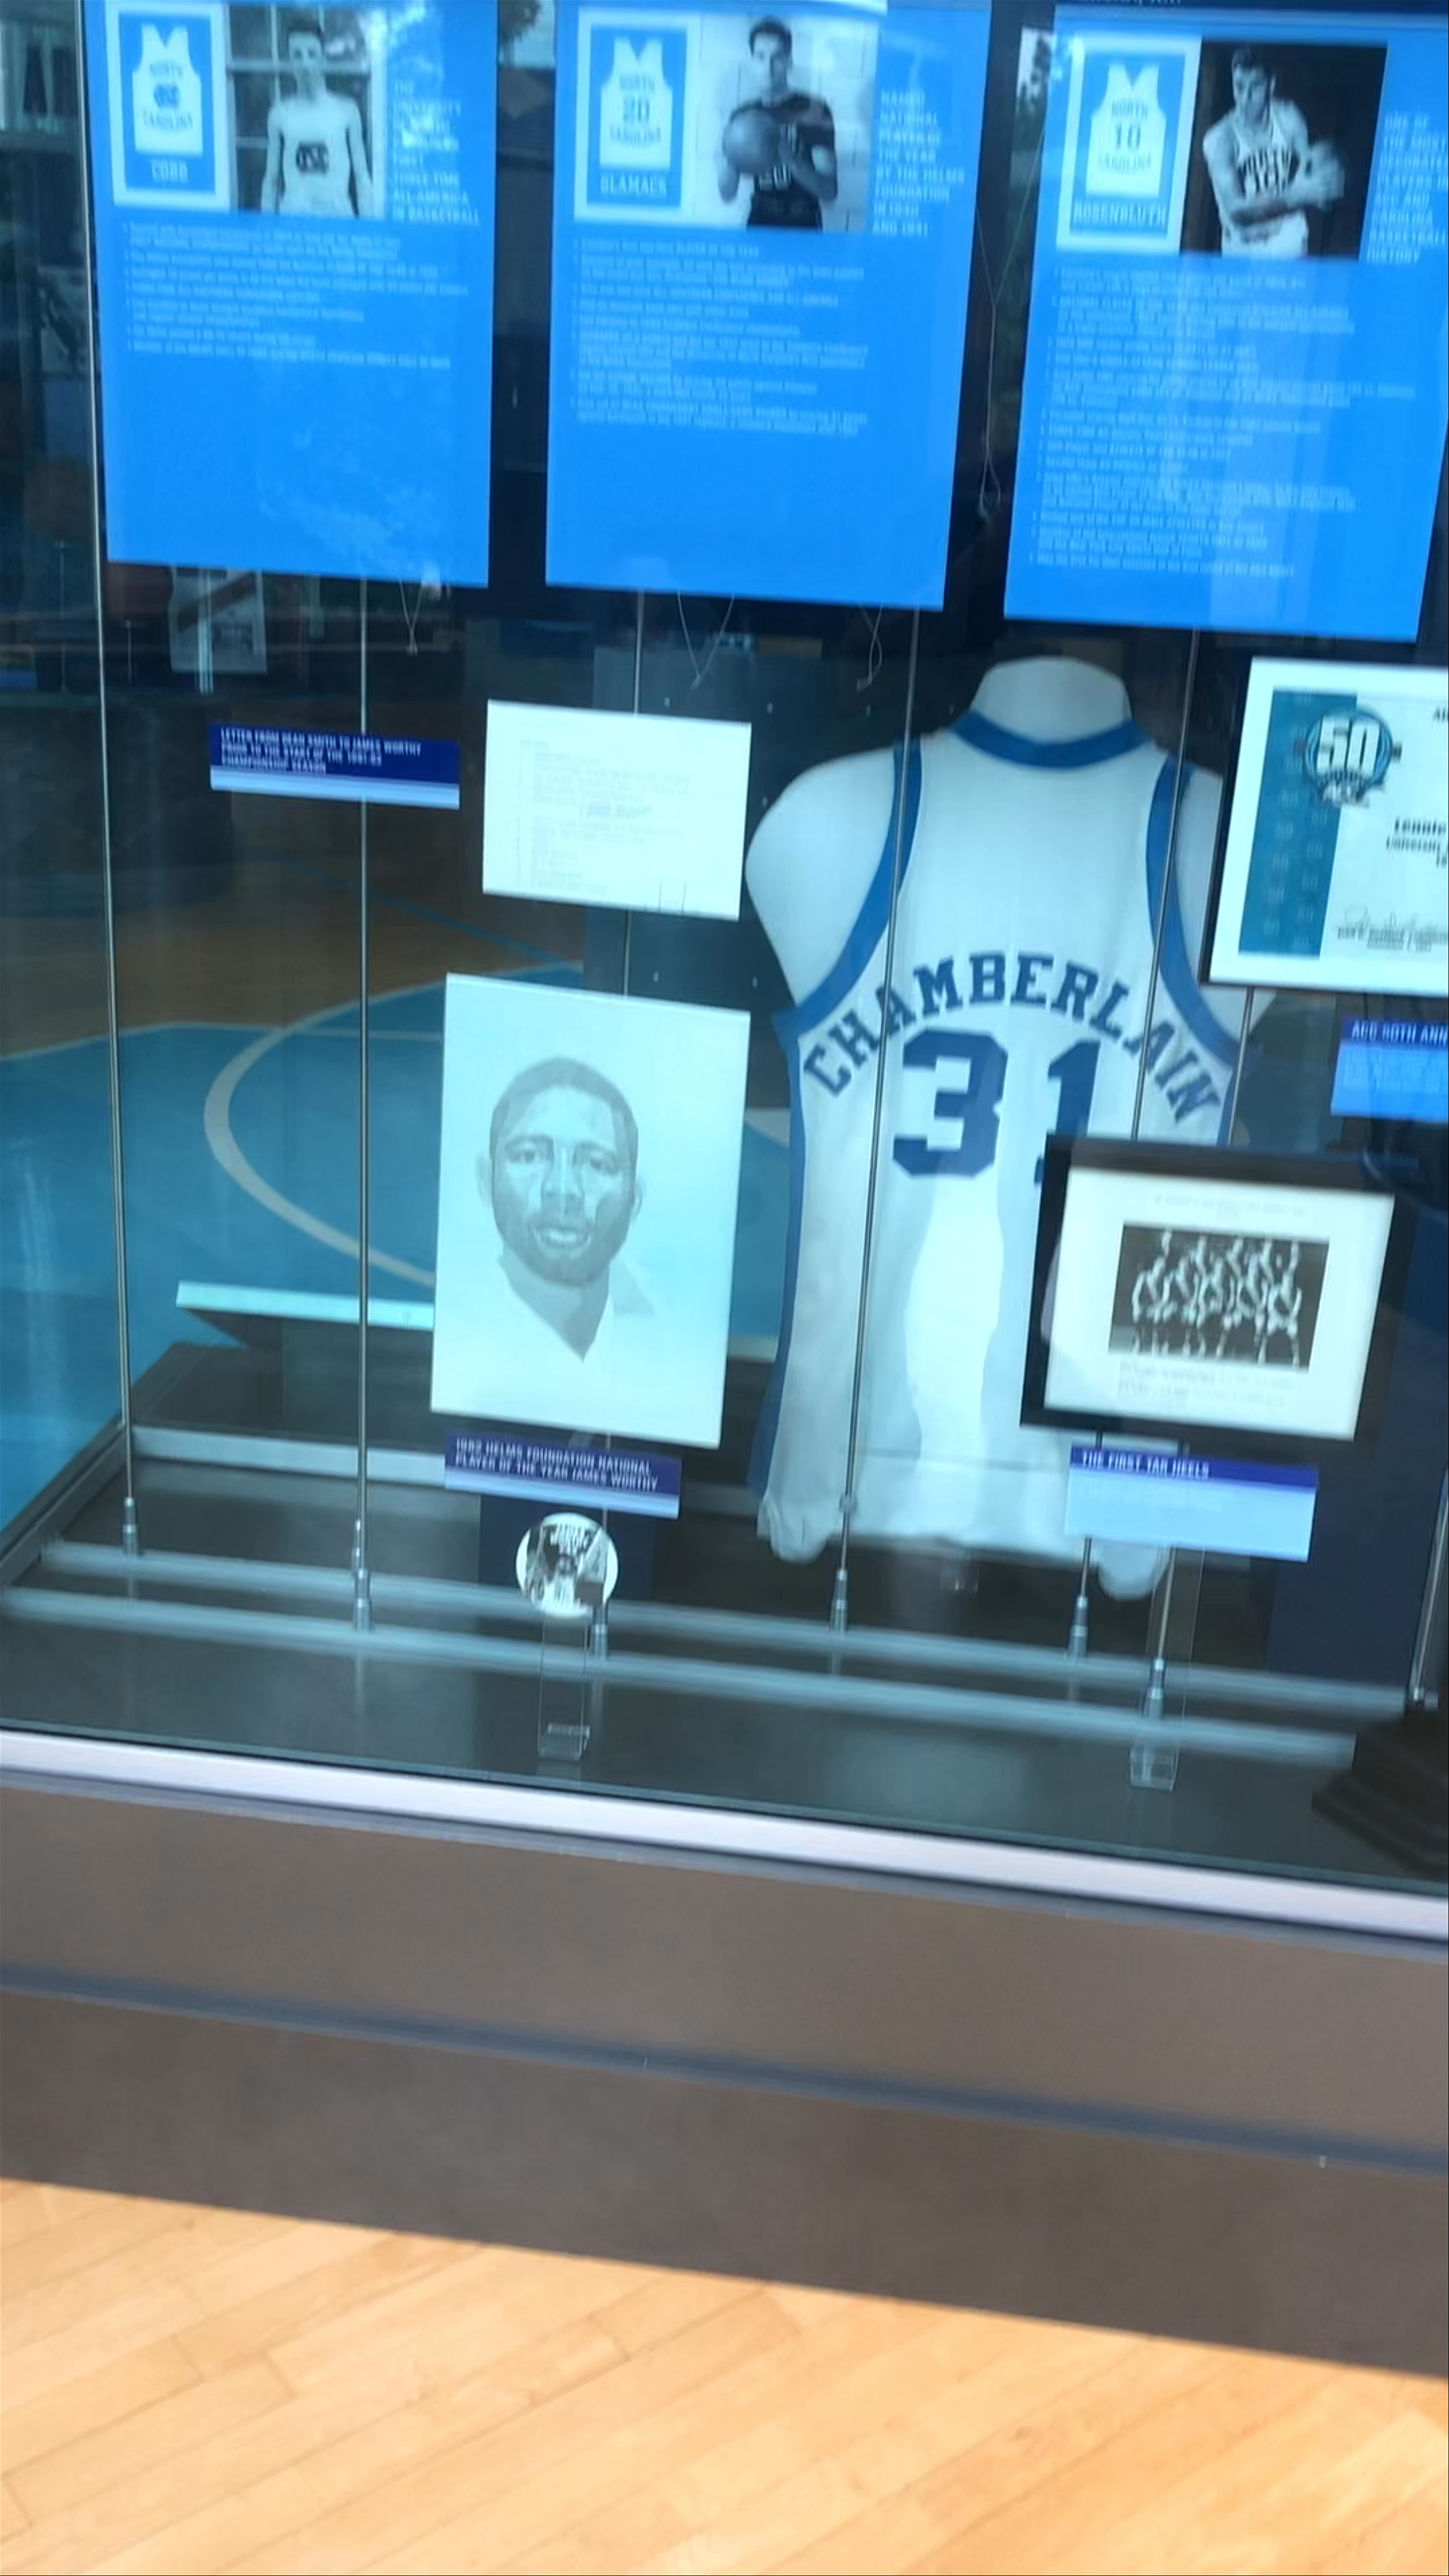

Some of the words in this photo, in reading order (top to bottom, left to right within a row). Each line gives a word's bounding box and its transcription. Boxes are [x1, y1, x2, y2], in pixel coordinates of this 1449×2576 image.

[384, 739, 421, 757] WORTHY
[1316, 716, 1380, 776] 50
[804, 951, 1220, 1123] CHAMBERLAIN
[892, 1026, 1101, 1186] 31
[455, 1453, 495, 1472] PLAYER
[499, 1458, 511, 1473] OF
[517, 1459, 536, 1476] THE
[540, 1463, 568, 1481] YEAR
[571, 1466, 607, 1485] JAMES
[610, 1469, 658, 1493] WORTHY
[526, 1445, 595, 1468] FOUNDATION
[598, 1453, 651, 1475] NATIONAL
[1083, 1449, 1104, 1470] THE
[1108, 1452, 1143, 1474] FIRST
[1147, 1455, 1169, 1477] TAR
[1172, 1458, 1210, 1481] HEELS
